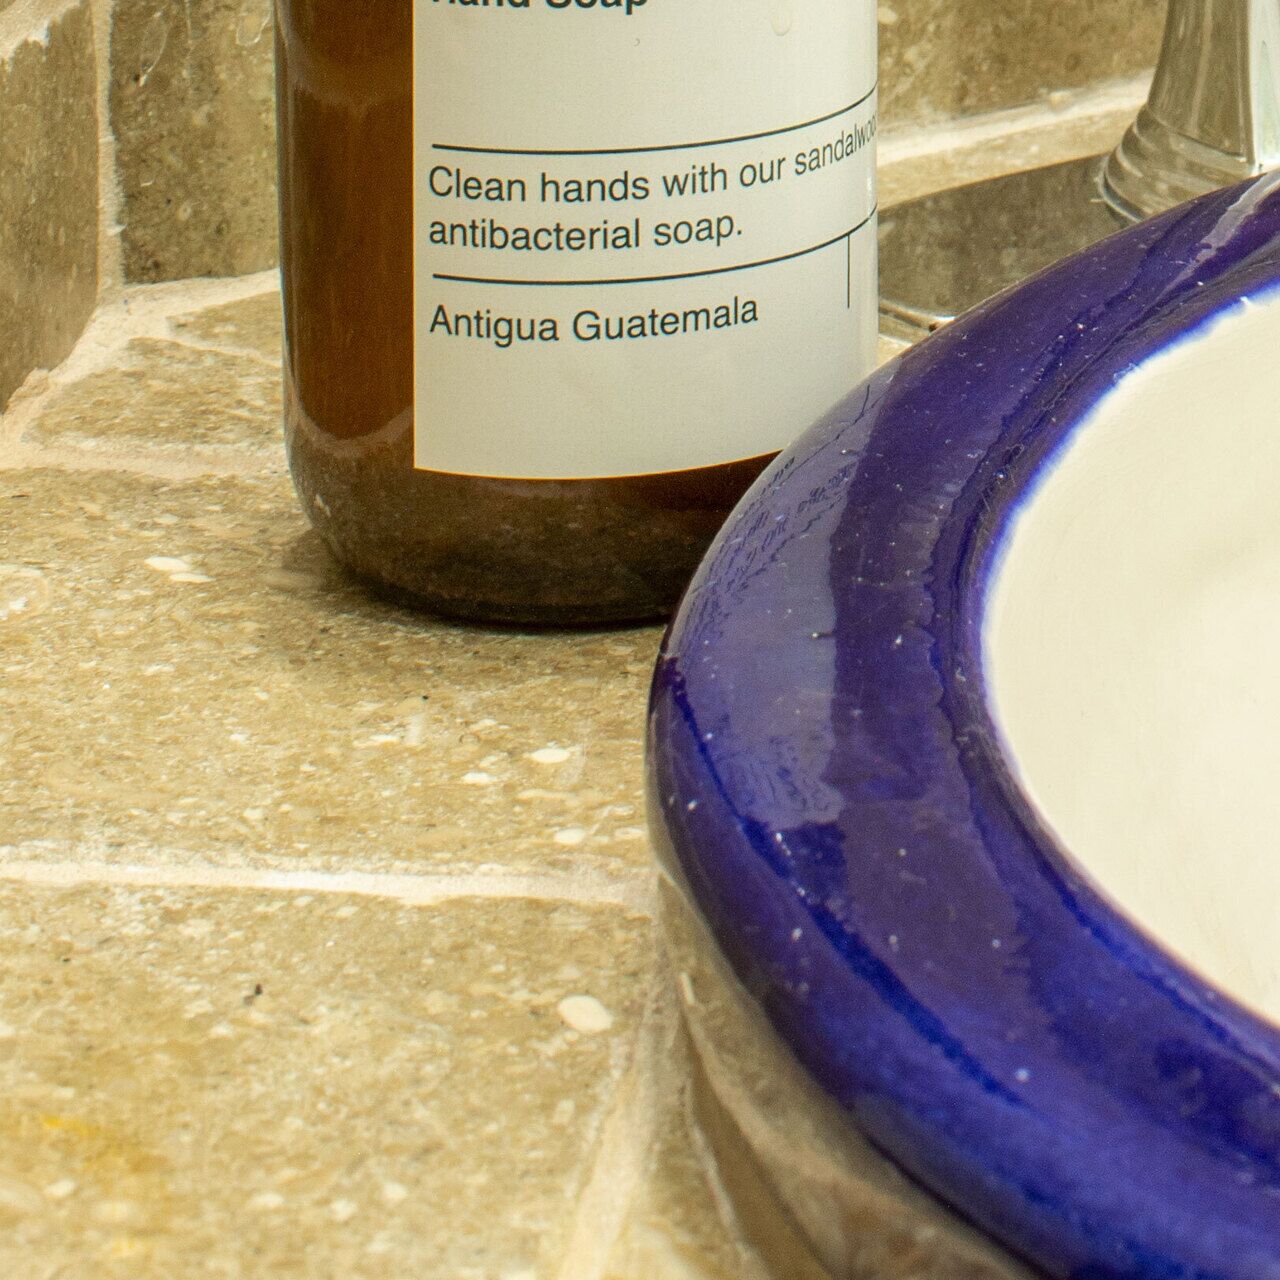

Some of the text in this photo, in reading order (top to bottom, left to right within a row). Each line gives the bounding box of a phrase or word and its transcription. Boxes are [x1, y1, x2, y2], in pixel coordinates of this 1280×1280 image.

[428, 111, 878, 203] Clean hands with our sandalwoo
[428, 213, 743, 252] antibacterial soap.
[429, 295, 760, 349] Antigua Guatemala
